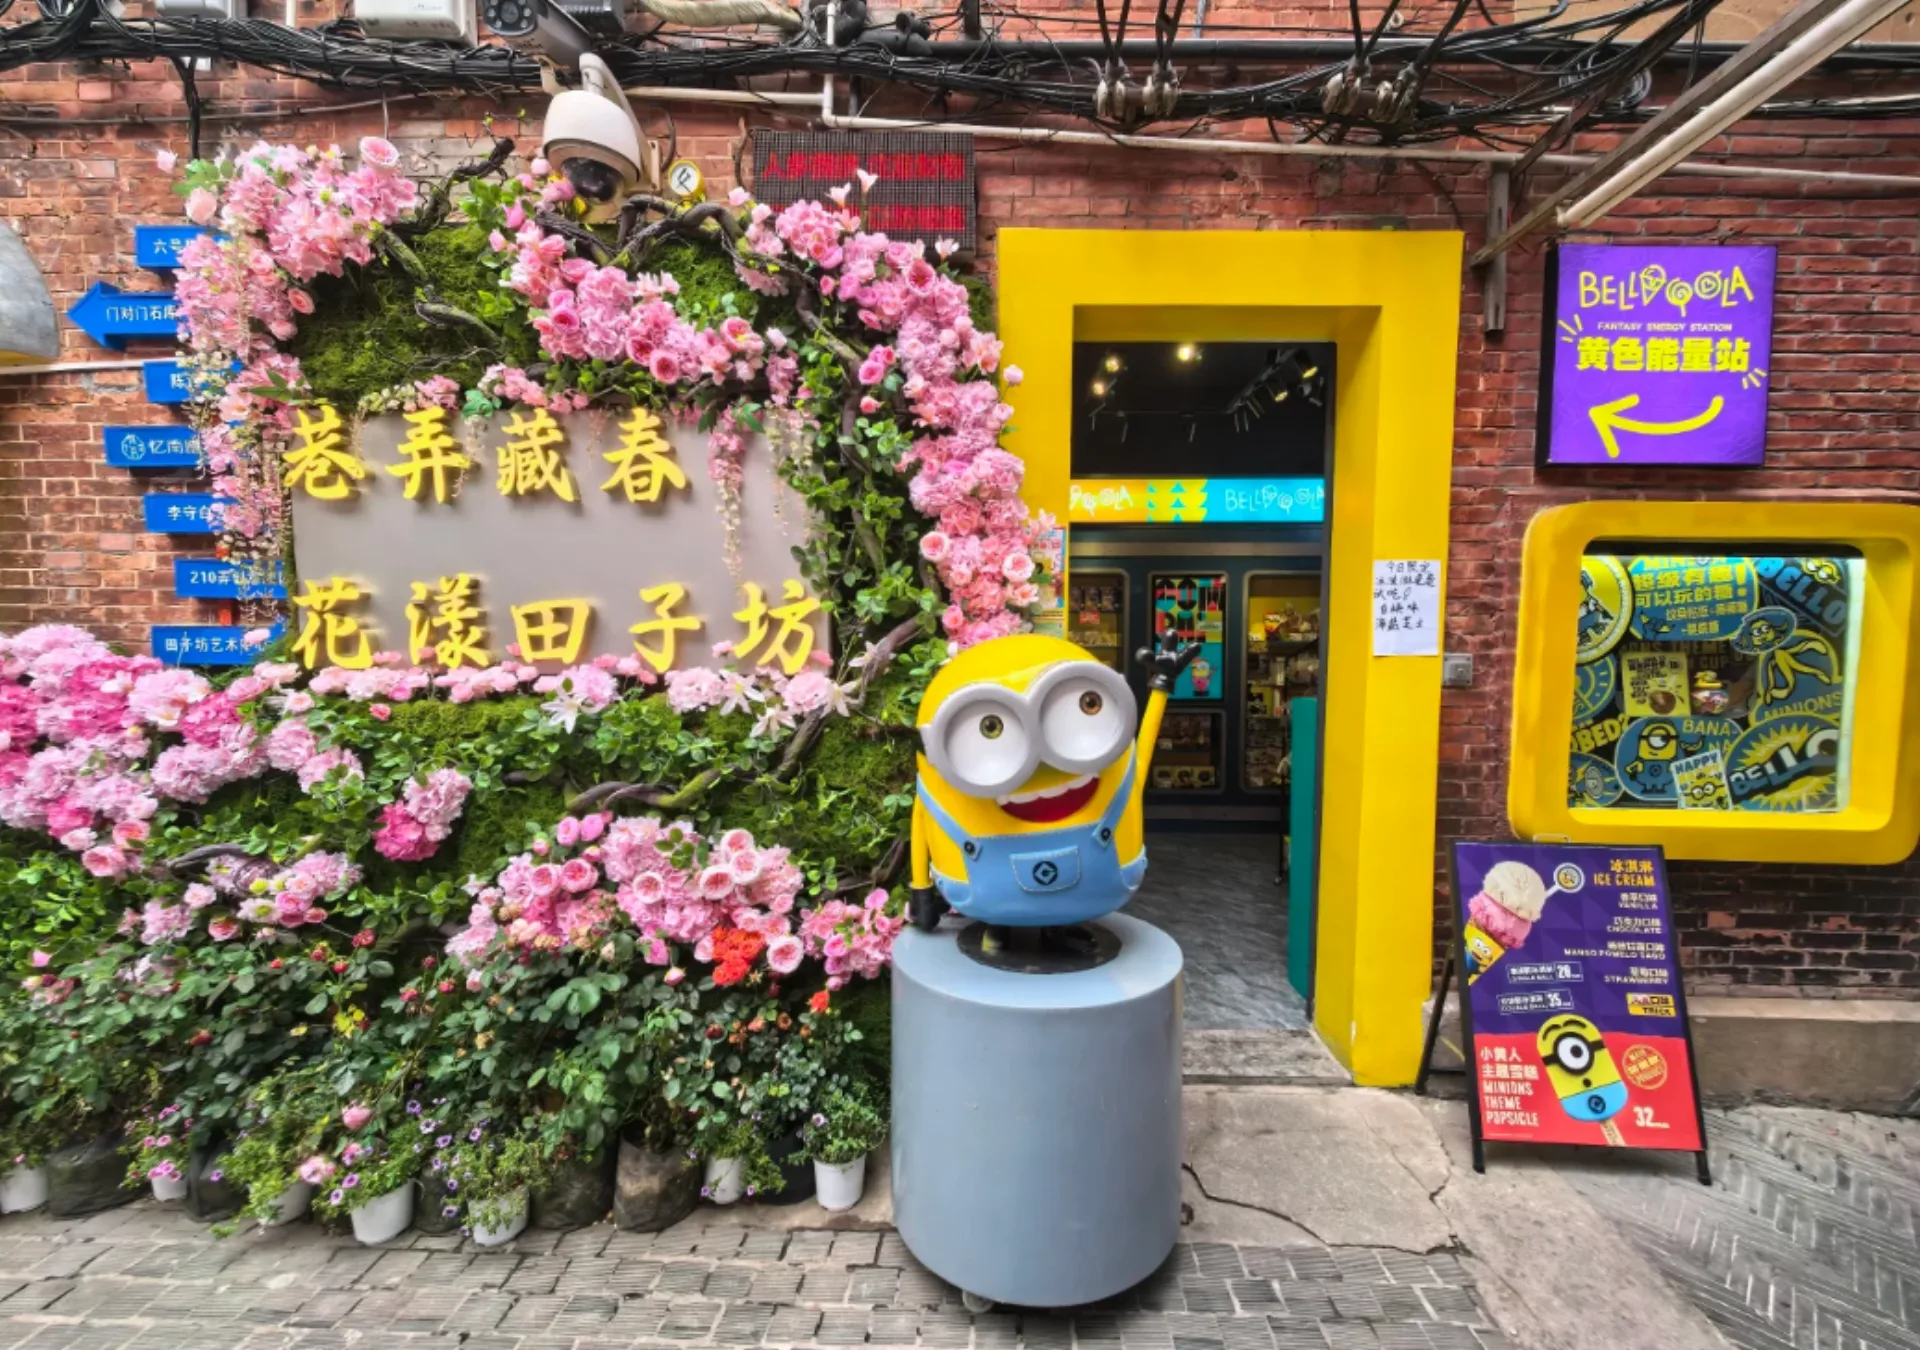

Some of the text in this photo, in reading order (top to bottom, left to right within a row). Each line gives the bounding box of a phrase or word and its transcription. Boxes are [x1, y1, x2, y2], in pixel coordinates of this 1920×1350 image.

[1597, 321, 1733, 332] FANTASY ENERGY STATION
[1576, 336, 1751, 372] 黄色能量站
[283, 404, 688, 504] 巷弄藏春
[292, 571, 823, 676] 花漾田子坊
[1610, 859, 1654, 872] 冰淇淋
[1593, 873, 1655, 887] ICE CREAM
[1480, 1047, 1522, 1062] 小黄人
[1482, 1063, 1539, 1080] 主题雪糕
[1482, 1081, 1534, 1096] MINIONS
[1483, 1096, 1522, 1110] THEME
[1486, 1111, 1540, 1127] POPSICLE
